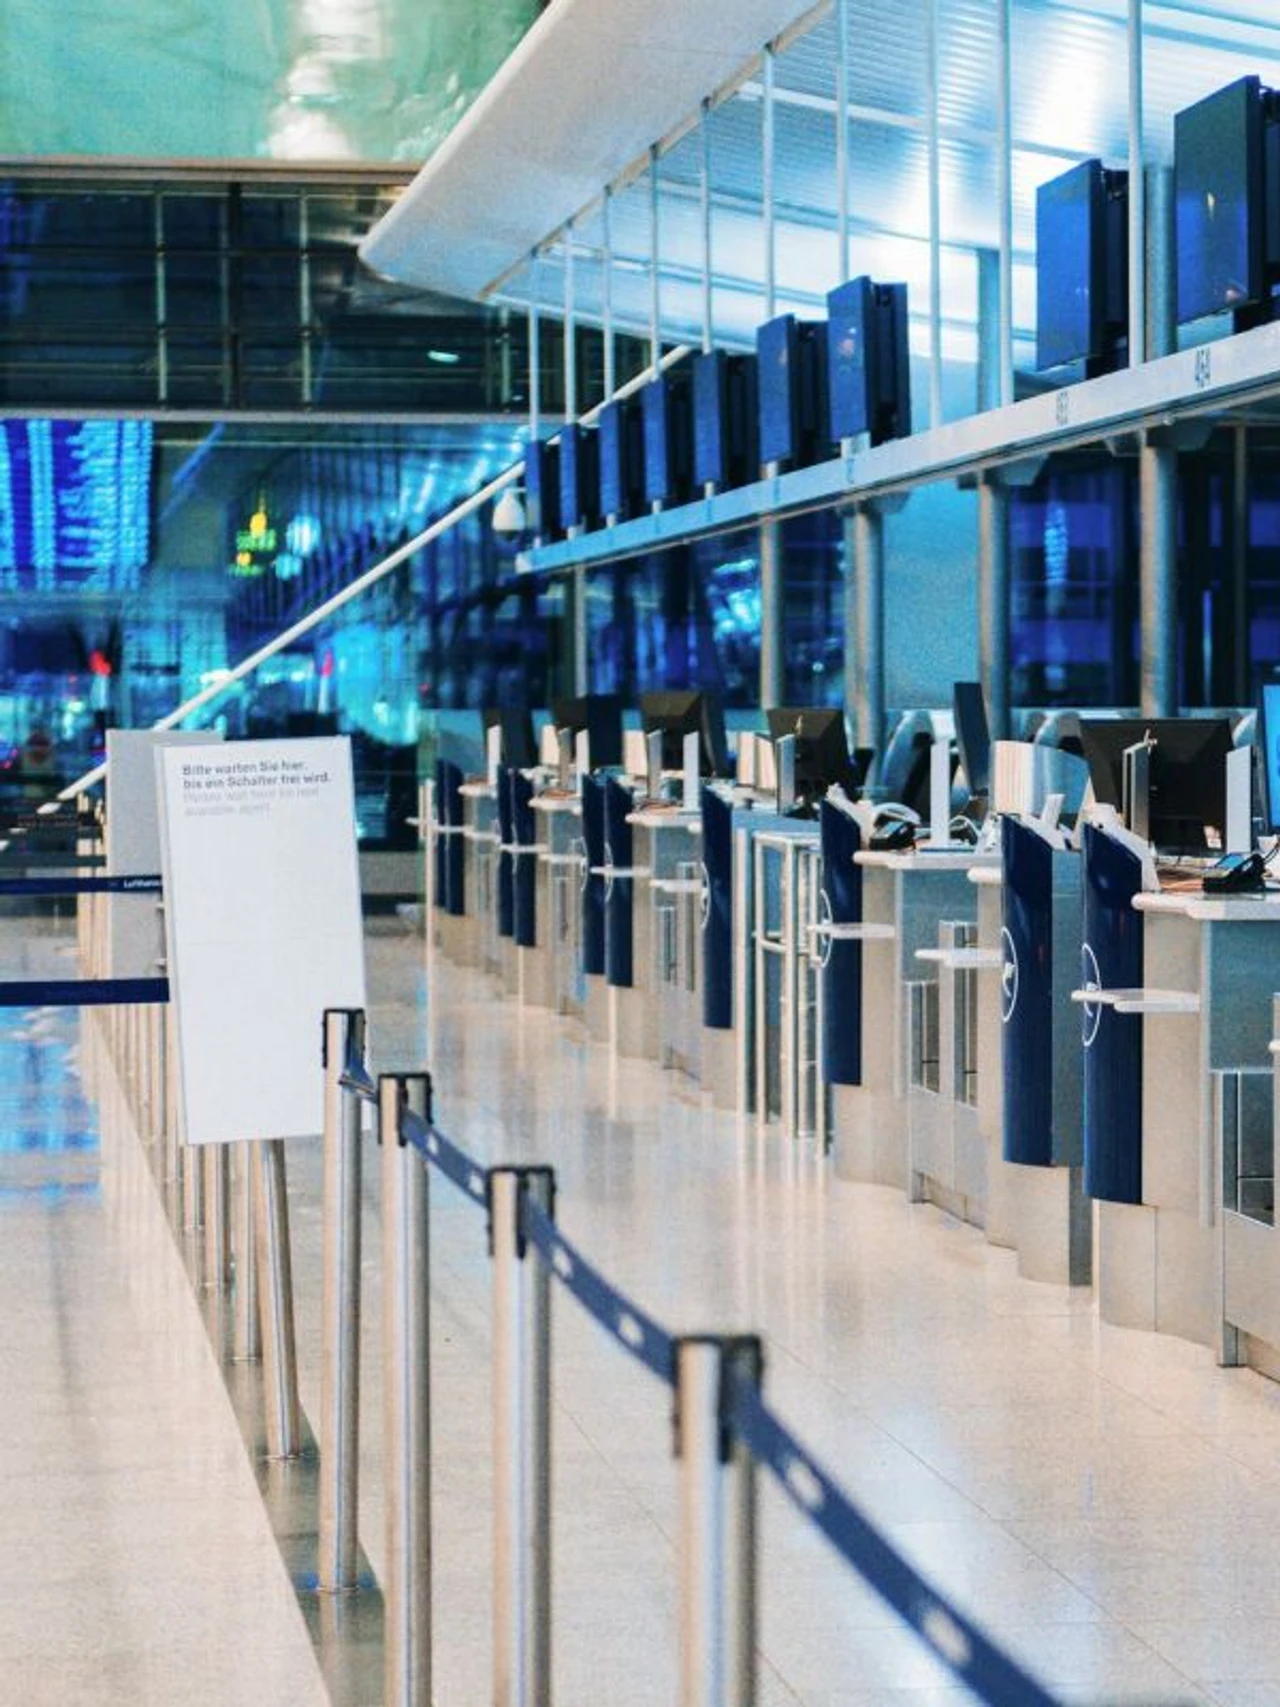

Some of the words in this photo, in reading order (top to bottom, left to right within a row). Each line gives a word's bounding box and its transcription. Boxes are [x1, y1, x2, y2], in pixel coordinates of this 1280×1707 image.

[182, 764, 211, 775] Bitte
[214, 763, 257, 774] warten
[260, 761, 278, 771] Sie
[183, 779, 202, 789] bis
[205, 779, 225, 788] ein
[227, 776, 279, 787] Schalter
[281, 775, 301, 785] frei
